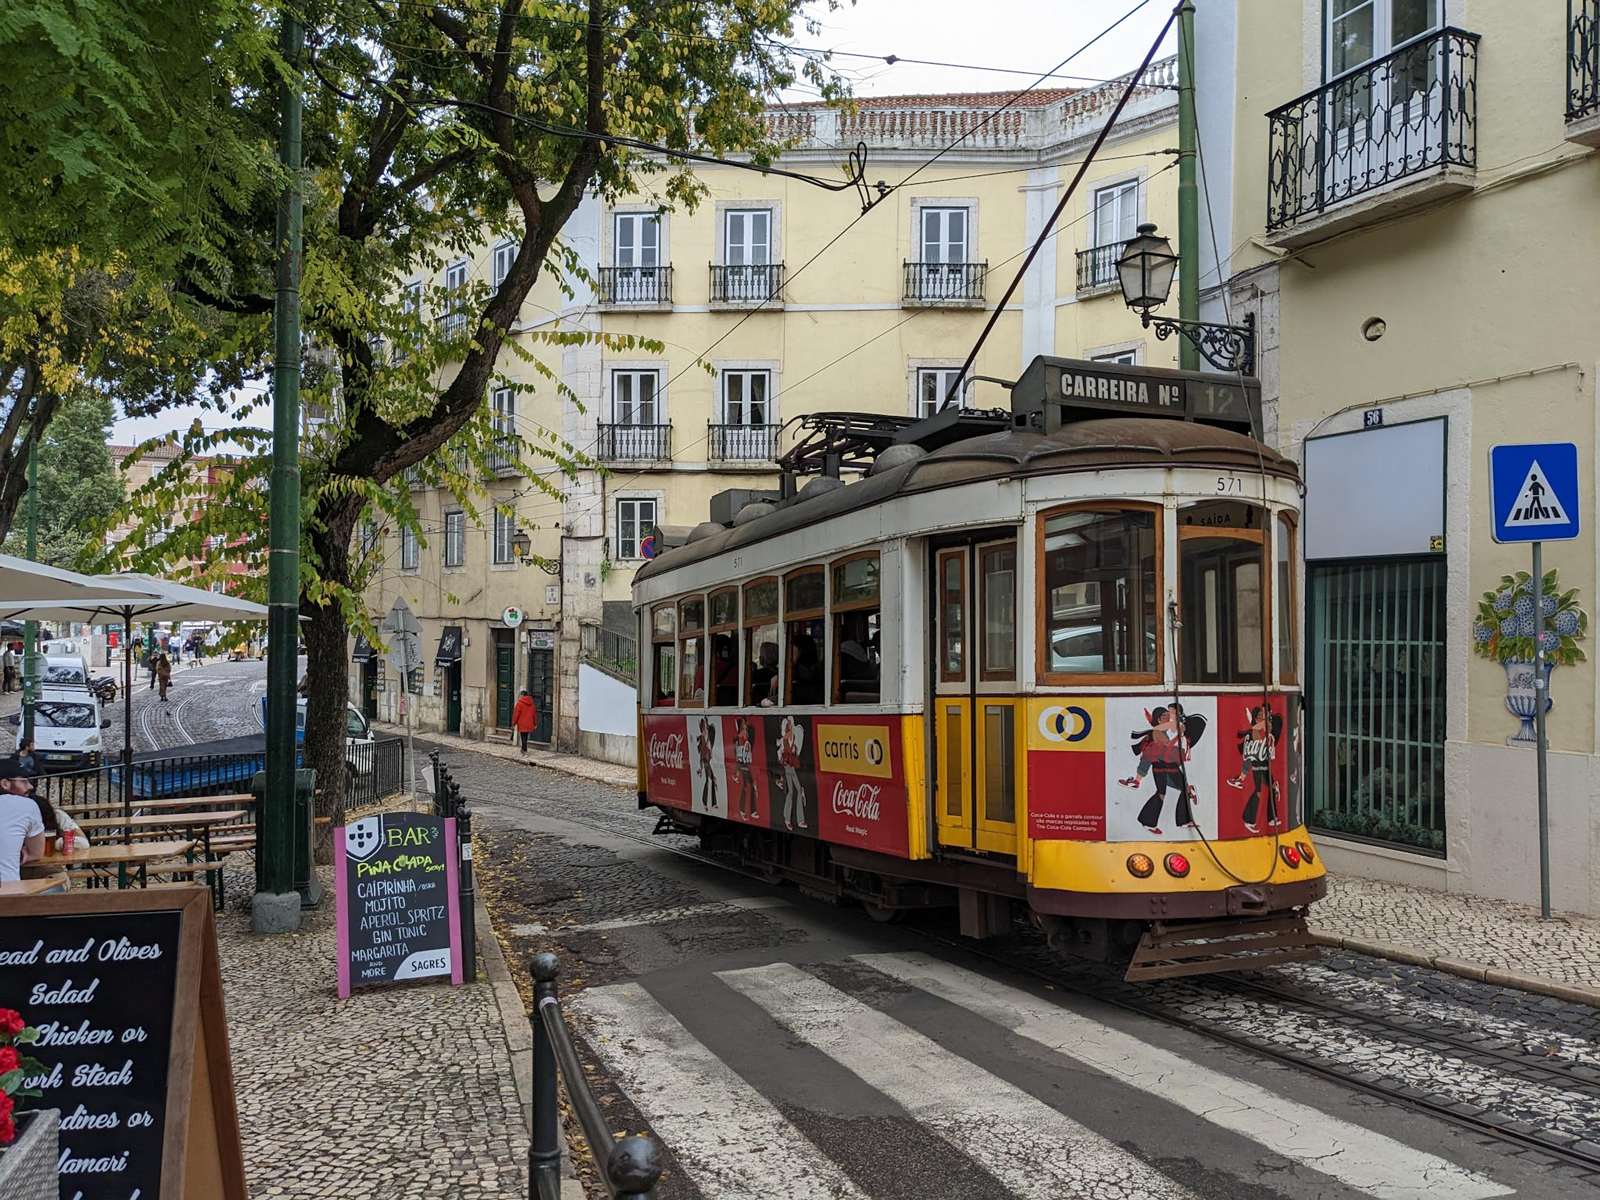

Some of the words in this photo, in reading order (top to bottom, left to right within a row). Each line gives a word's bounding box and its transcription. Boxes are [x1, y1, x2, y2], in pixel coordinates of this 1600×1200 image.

[1061, 373, 1149, 404] CARREIRA
[1205, 385, 1234, 414] 12
[1366, 410, 1380, 425] 56
[1217, 477, 1242, 492] 571
[733, 556, 743, 569] 571
[649, 733, 684, 769] Coca-Cola
[824, 735, 859, 760] carris
[832, 780, 881, 820] Coca-Cola
[387, 827, 431, 847] BAR
[357, 878, 417, 899] CAIPIRINHA
[360, 912, 405, 930] APEROL
[407, 905, 445, 925] SPRITZ
[365, 896, 406, 914] MOJITO
[373, 929, 392, 944] GIN
[396, 924, 427, 940] TONIC
[0, 939, 44, 966] ead
[45, 937, 95, 964] and
[98, 936, 163, 962] Olives
[351, 942, 410, 962] MARGARITA
[361, 967, 387, 978] MORE
[411, 957, 446, 972] SAGRES
[29, 977, 100, 1006] Salad
[31, 1019, 115, 1047] Chicken
[121, 1026, 149, 1043] or
[22, 1062, 63, 1089] ork
[71, 1059, 134, 1087] Steak
[58, 1104, 121, 1131] dines
[127, 1111, 155, 1128] or
[58, 1147, 130, 1174] lamari
